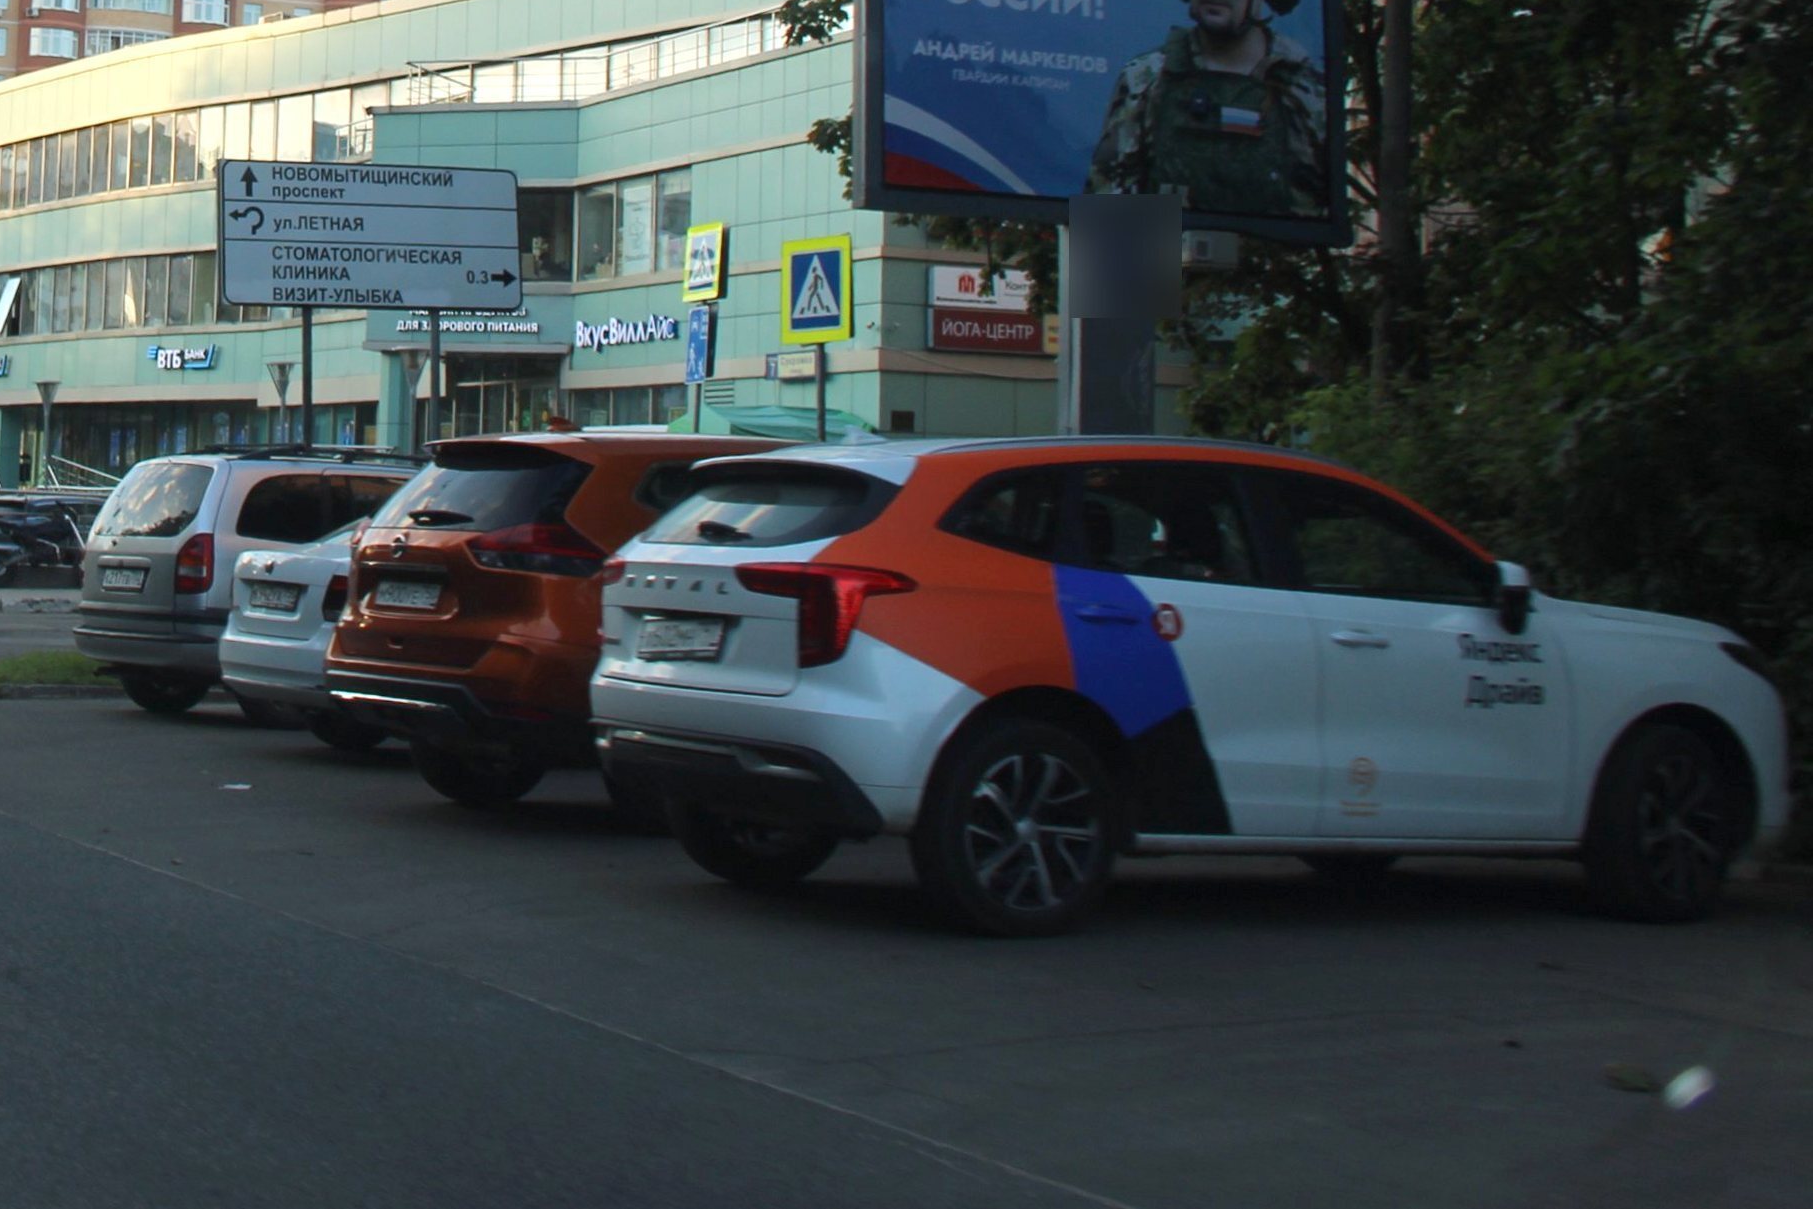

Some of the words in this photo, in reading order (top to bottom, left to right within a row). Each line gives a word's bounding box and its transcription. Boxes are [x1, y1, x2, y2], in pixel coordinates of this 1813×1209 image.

[912, 40, 995, 63] АНДРЕЙ
[1001, 49, 1108, 73] МАРКЕЛОВ
[272, 166, 454, 188] НОВОМЫТИЩИНСКИЙ
[272, 185, 346, 200] проспект
[272, 245, 462, 265] СТОМАТОЛОГИЧЕСКАЯ
[272, 265, 351, 281] КЛИНИКА
[466, 270, 489, 285] 0.3
[272, 287, 404, 304] ВИЗИТ-УЛЫБКА
[396, 320, 419, 331] ДЛЯ
[421, 320, 485, 332] ЗРОВОГО
[487, 321, 539, 333] ПИТАНИЯ
[941, 318, 1035, 341] ЙОГА-ЦЕНТР
[157, 349, 182, 369] ВТБ
